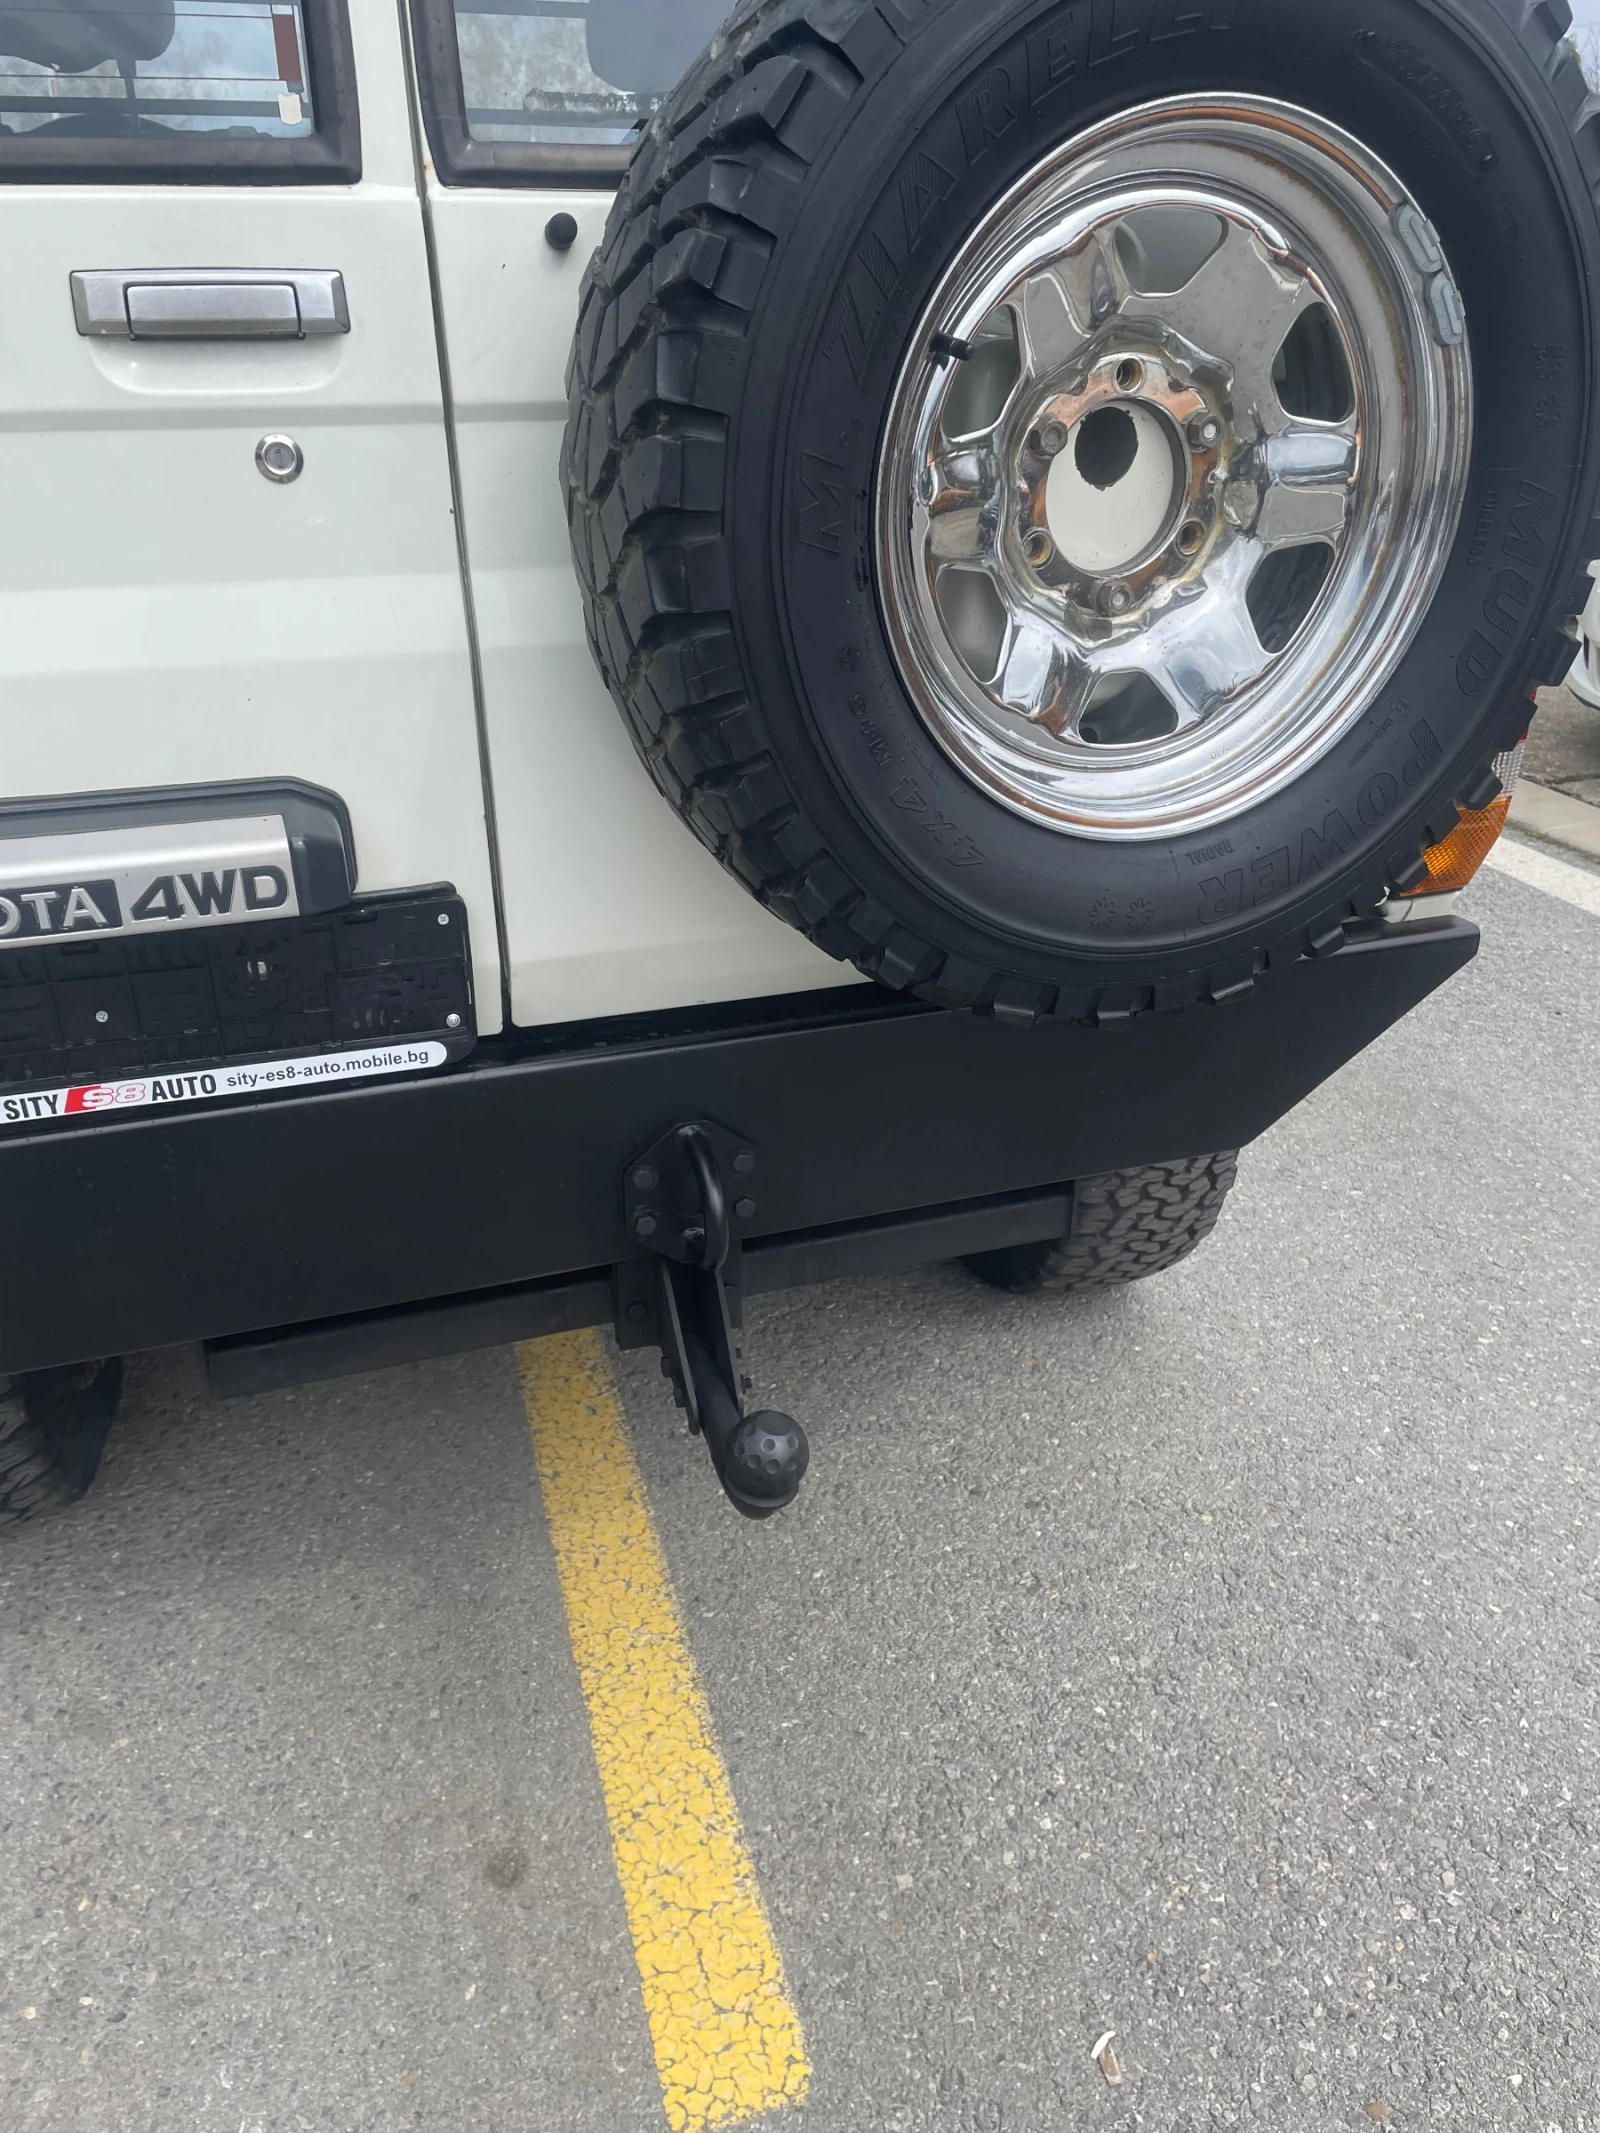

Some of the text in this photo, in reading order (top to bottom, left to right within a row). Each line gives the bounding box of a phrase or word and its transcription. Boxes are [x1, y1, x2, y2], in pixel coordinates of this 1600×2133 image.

[1197, 478, 1559, 925] MUD POWER
[1185, 838, 1234, 867] RADIAL
[130, 865, 290, 921] 4WD
[3, 1094, 59, 1120] SITY
[151, 1074, 217, 1101] AUTO
[226, 1050, 430, 1088] sity-es8-auto.mobile.bg
